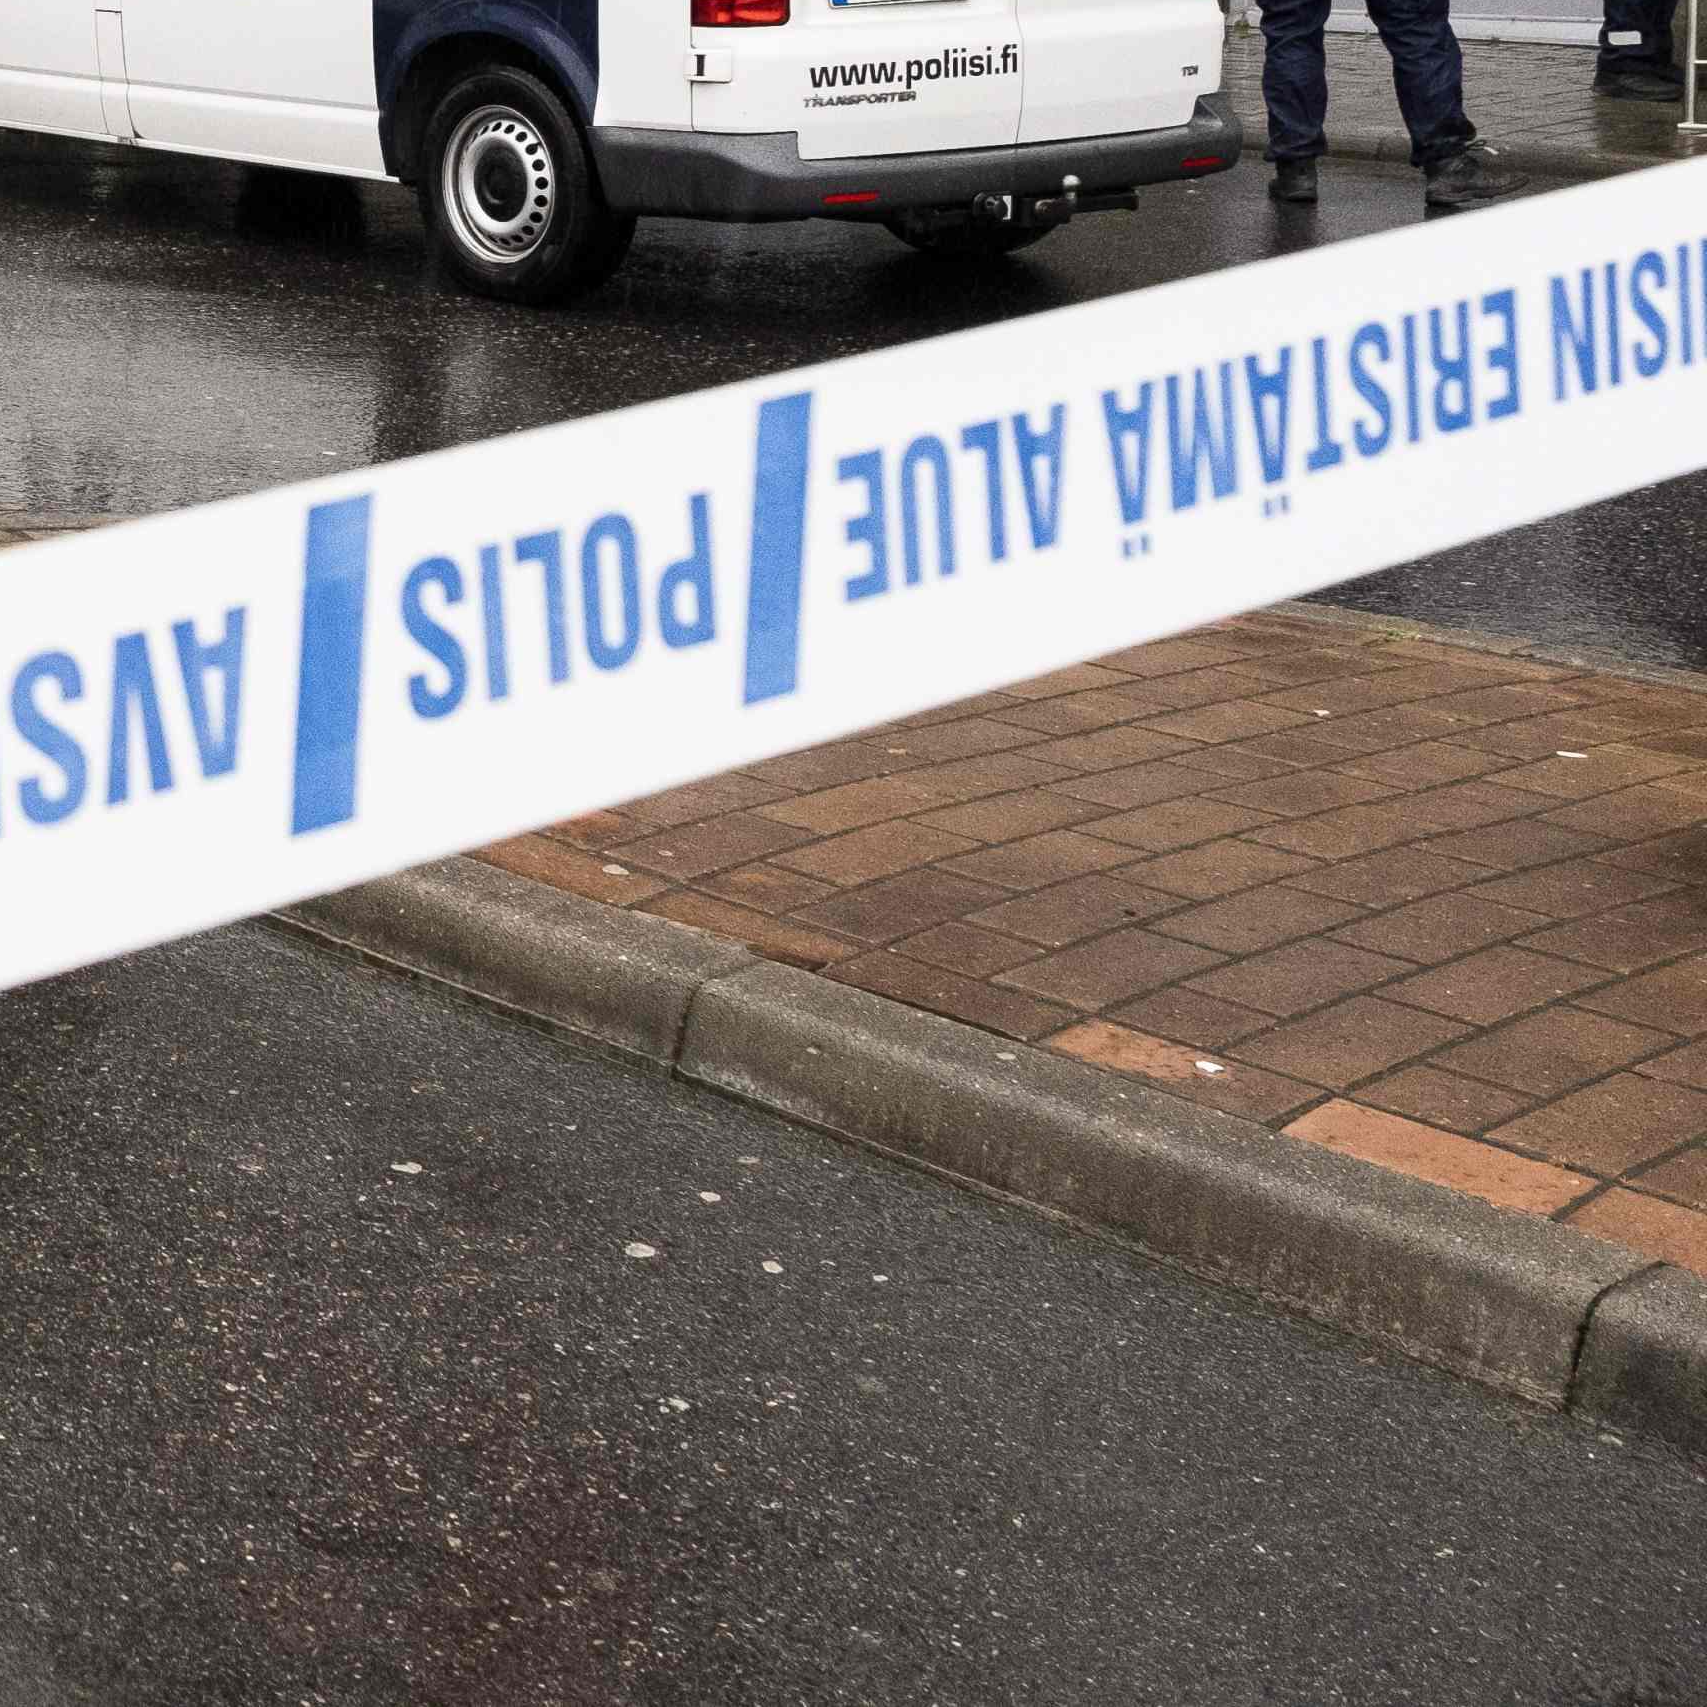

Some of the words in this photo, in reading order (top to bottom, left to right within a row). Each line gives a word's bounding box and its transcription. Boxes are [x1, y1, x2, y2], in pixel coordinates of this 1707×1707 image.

[802, 90, 918, 109] TRANSPORTER
[808, 43, 1019, 91] www.poliisi.fi
[834, 400, 1068, 604] ALUE
[1098, 286, 1522, 558] ERISTÄMÄ
[398, 490, 719, 722] POLIS
